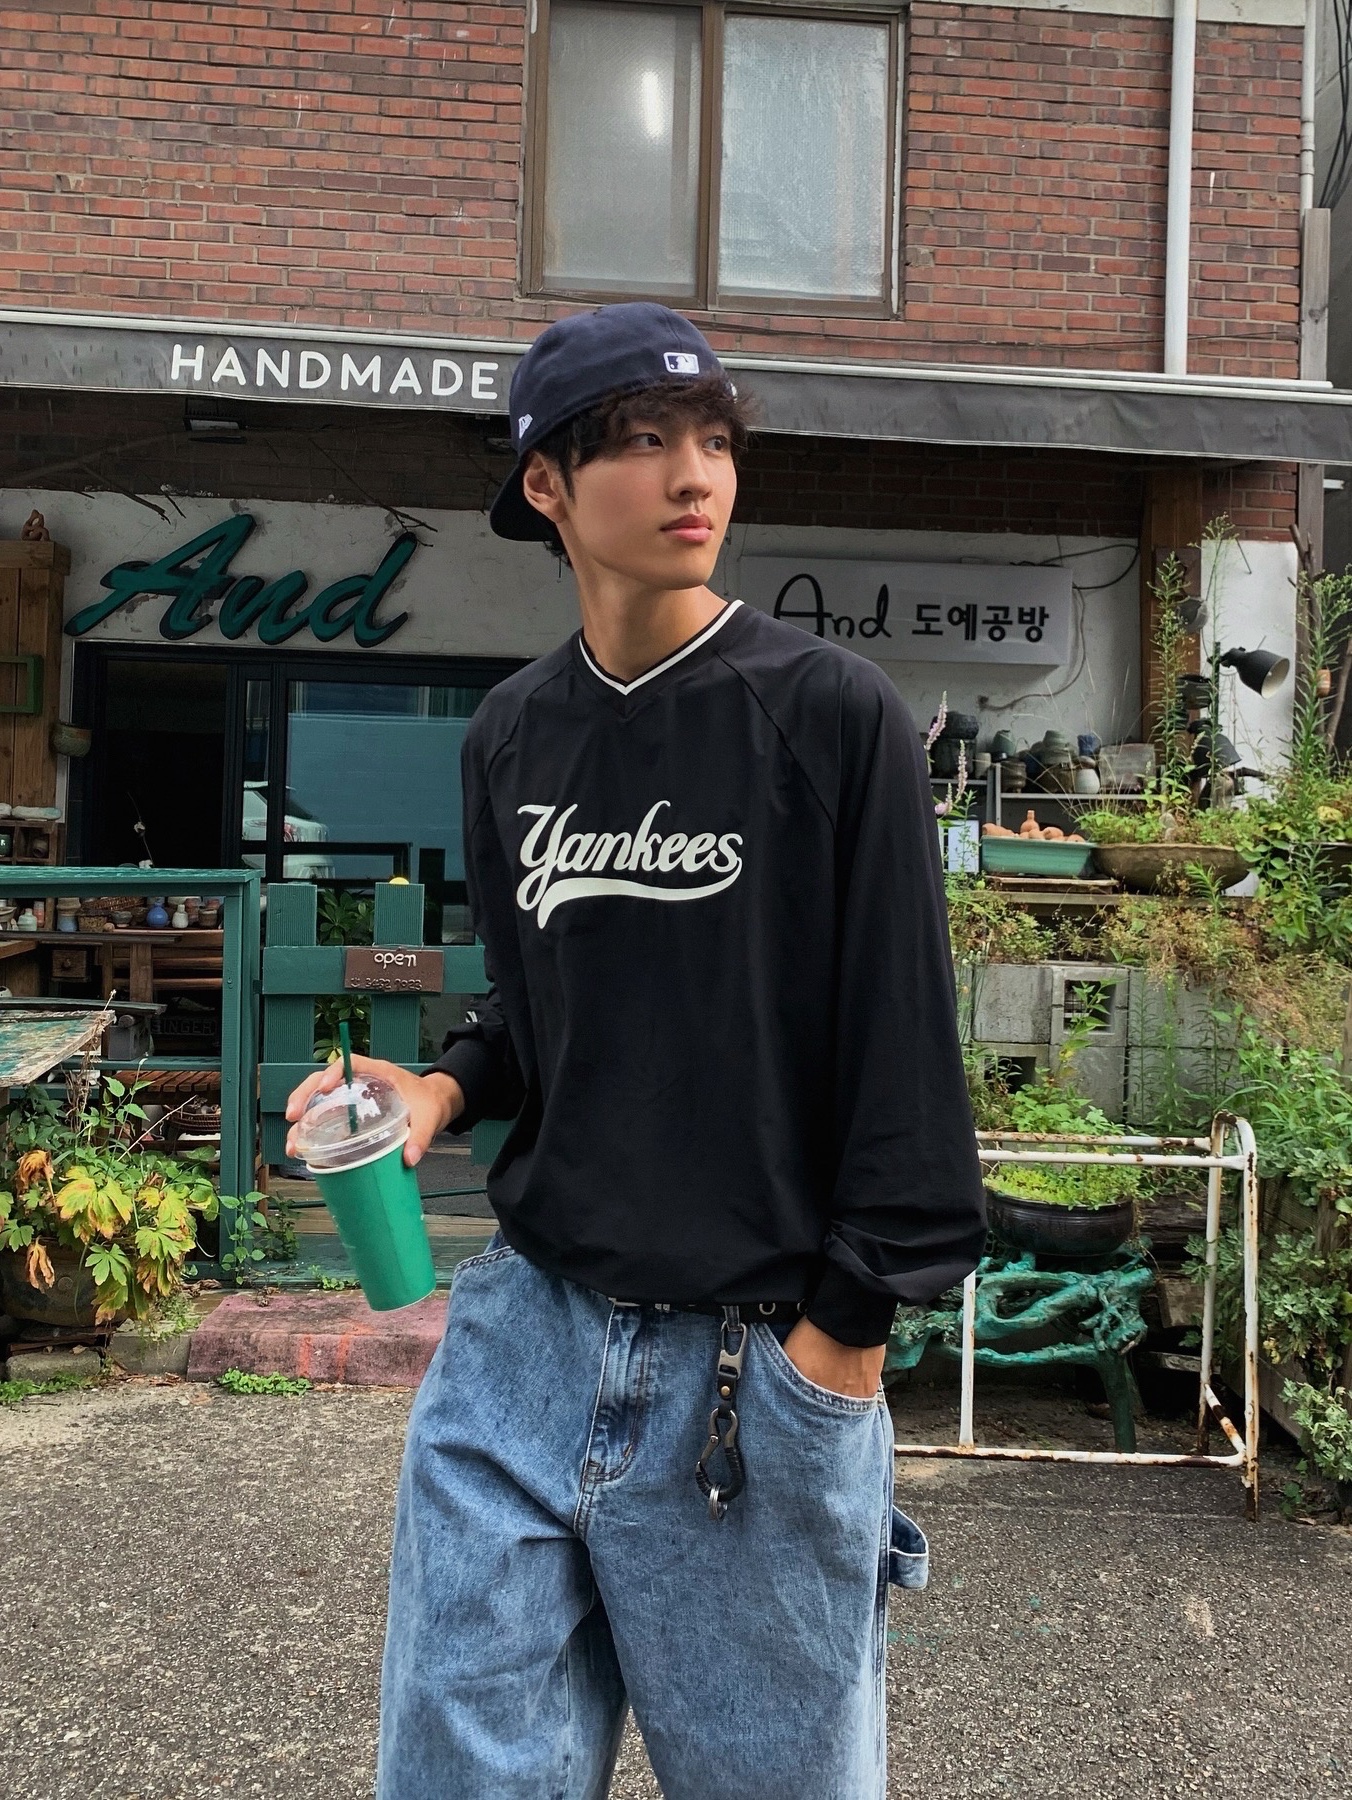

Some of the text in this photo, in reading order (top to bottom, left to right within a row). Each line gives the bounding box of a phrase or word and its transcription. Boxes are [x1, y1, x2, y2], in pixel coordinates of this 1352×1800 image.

[171, 344, 499, 399] HANDMADE
[64, 514, 417, 648] And
[773, 573, 1050, 643] And 도예공방
[516, 800, 743, 929] Yankees
[374, 952, 417, 969] open
[151, 1020, 213, 1034] SINGER
